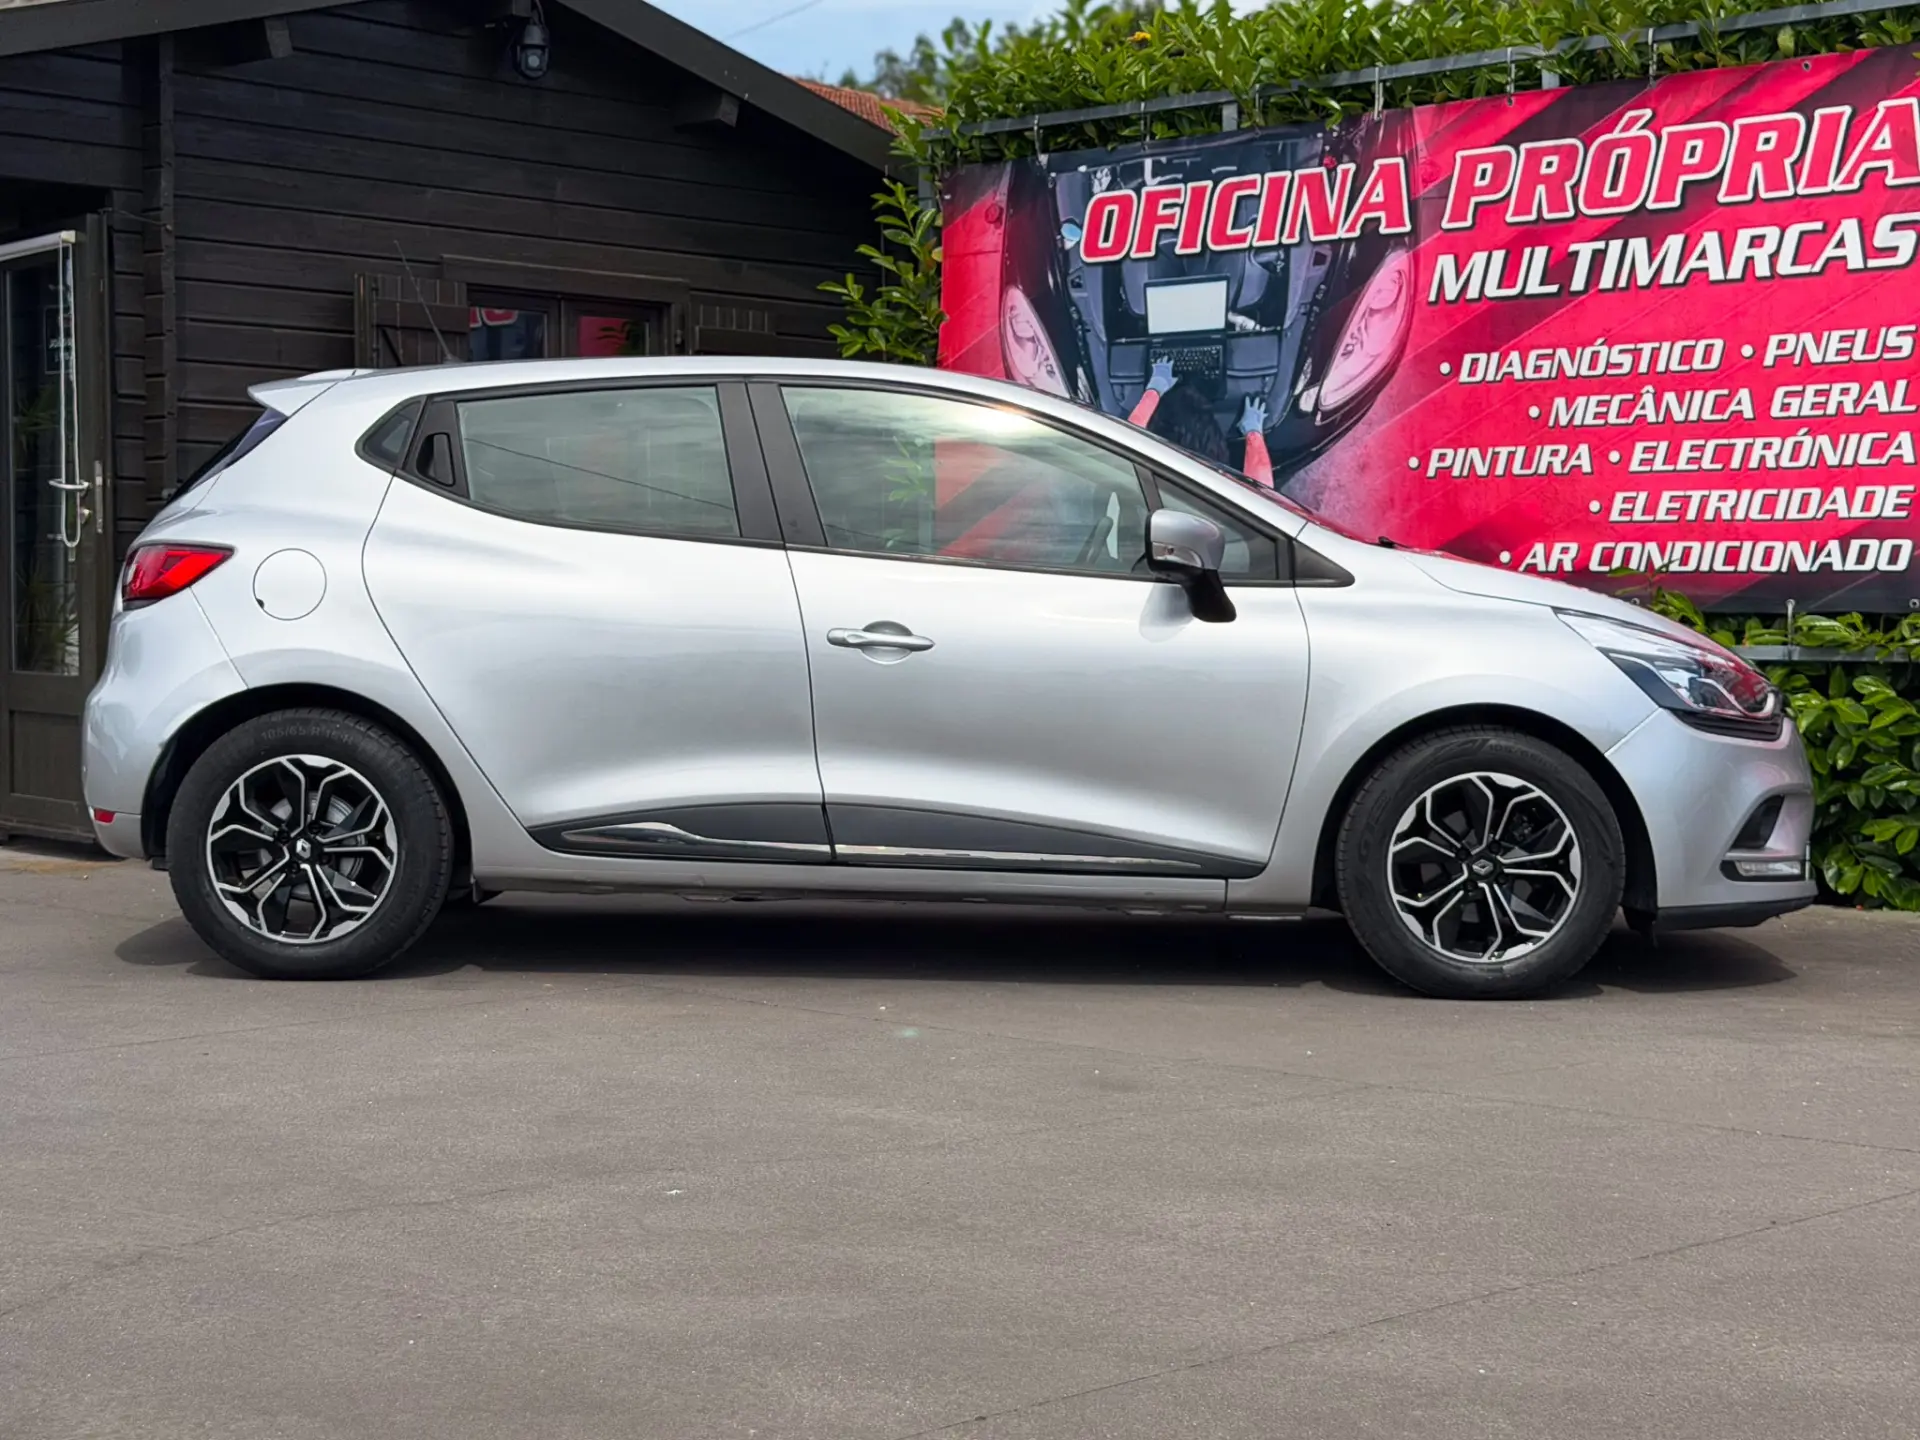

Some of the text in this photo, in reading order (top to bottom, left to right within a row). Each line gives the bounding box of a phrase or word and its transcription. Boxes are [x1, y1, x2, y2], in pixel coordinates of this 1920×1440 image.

[1079, 97, 1920, 263] OFICINA PRÓPRIA
[1429, 212, 1920, 302] MULTIMARCAS
[1459, 325, 1917, 383] DIAGNÓSTICO PNEUS
[1549, 380, 1917, 427] MECÂNICA GERAL
[1427, 428, 1915, 477] PINTURA ELECTRÓNICA
[1610, 485, 1915, 522] ELETRICIDADE
[1517, 538, 1913, 573] AR CONDICIONADO
